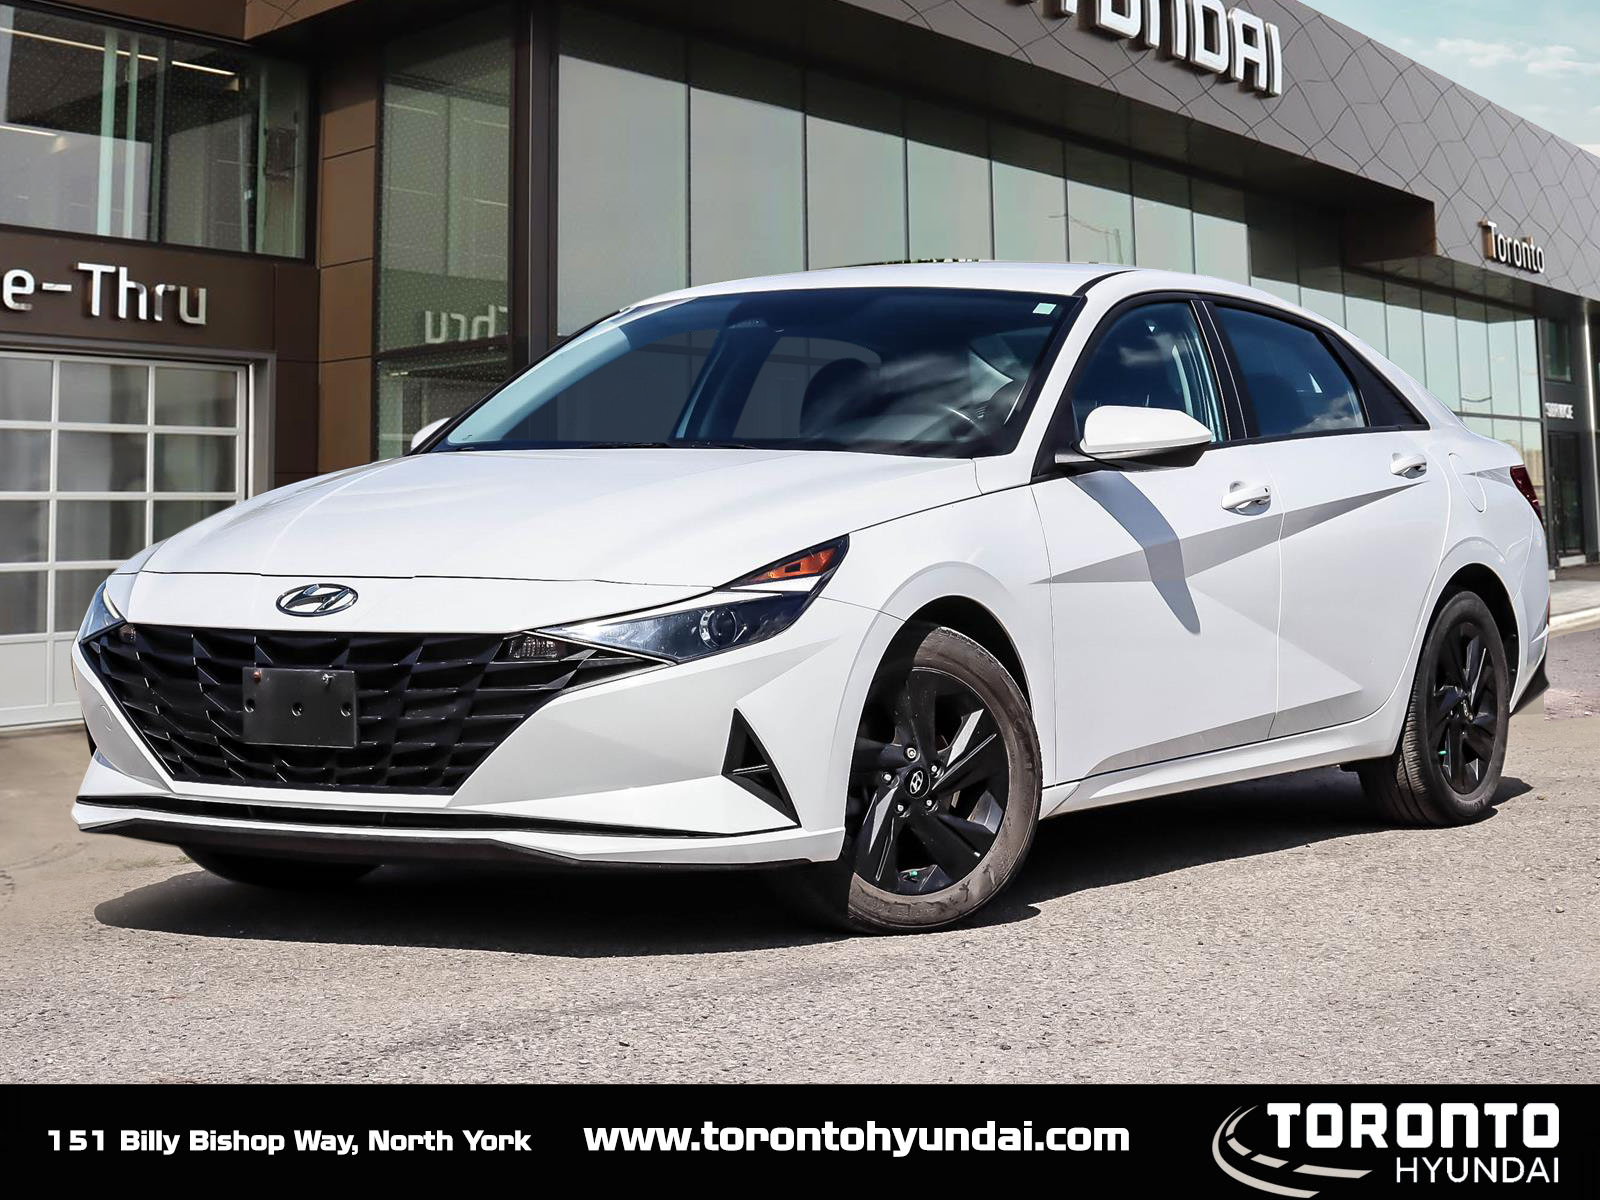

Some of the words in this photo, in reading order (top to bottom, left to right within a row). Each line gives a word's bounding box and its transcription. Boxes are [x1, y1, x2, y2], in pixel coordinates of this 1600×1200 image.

[1061, 0, 1283, 97] NDAI
[1486, 221, 1545, 273] Toronto
[2, 262, 207, 325] e-Thru
